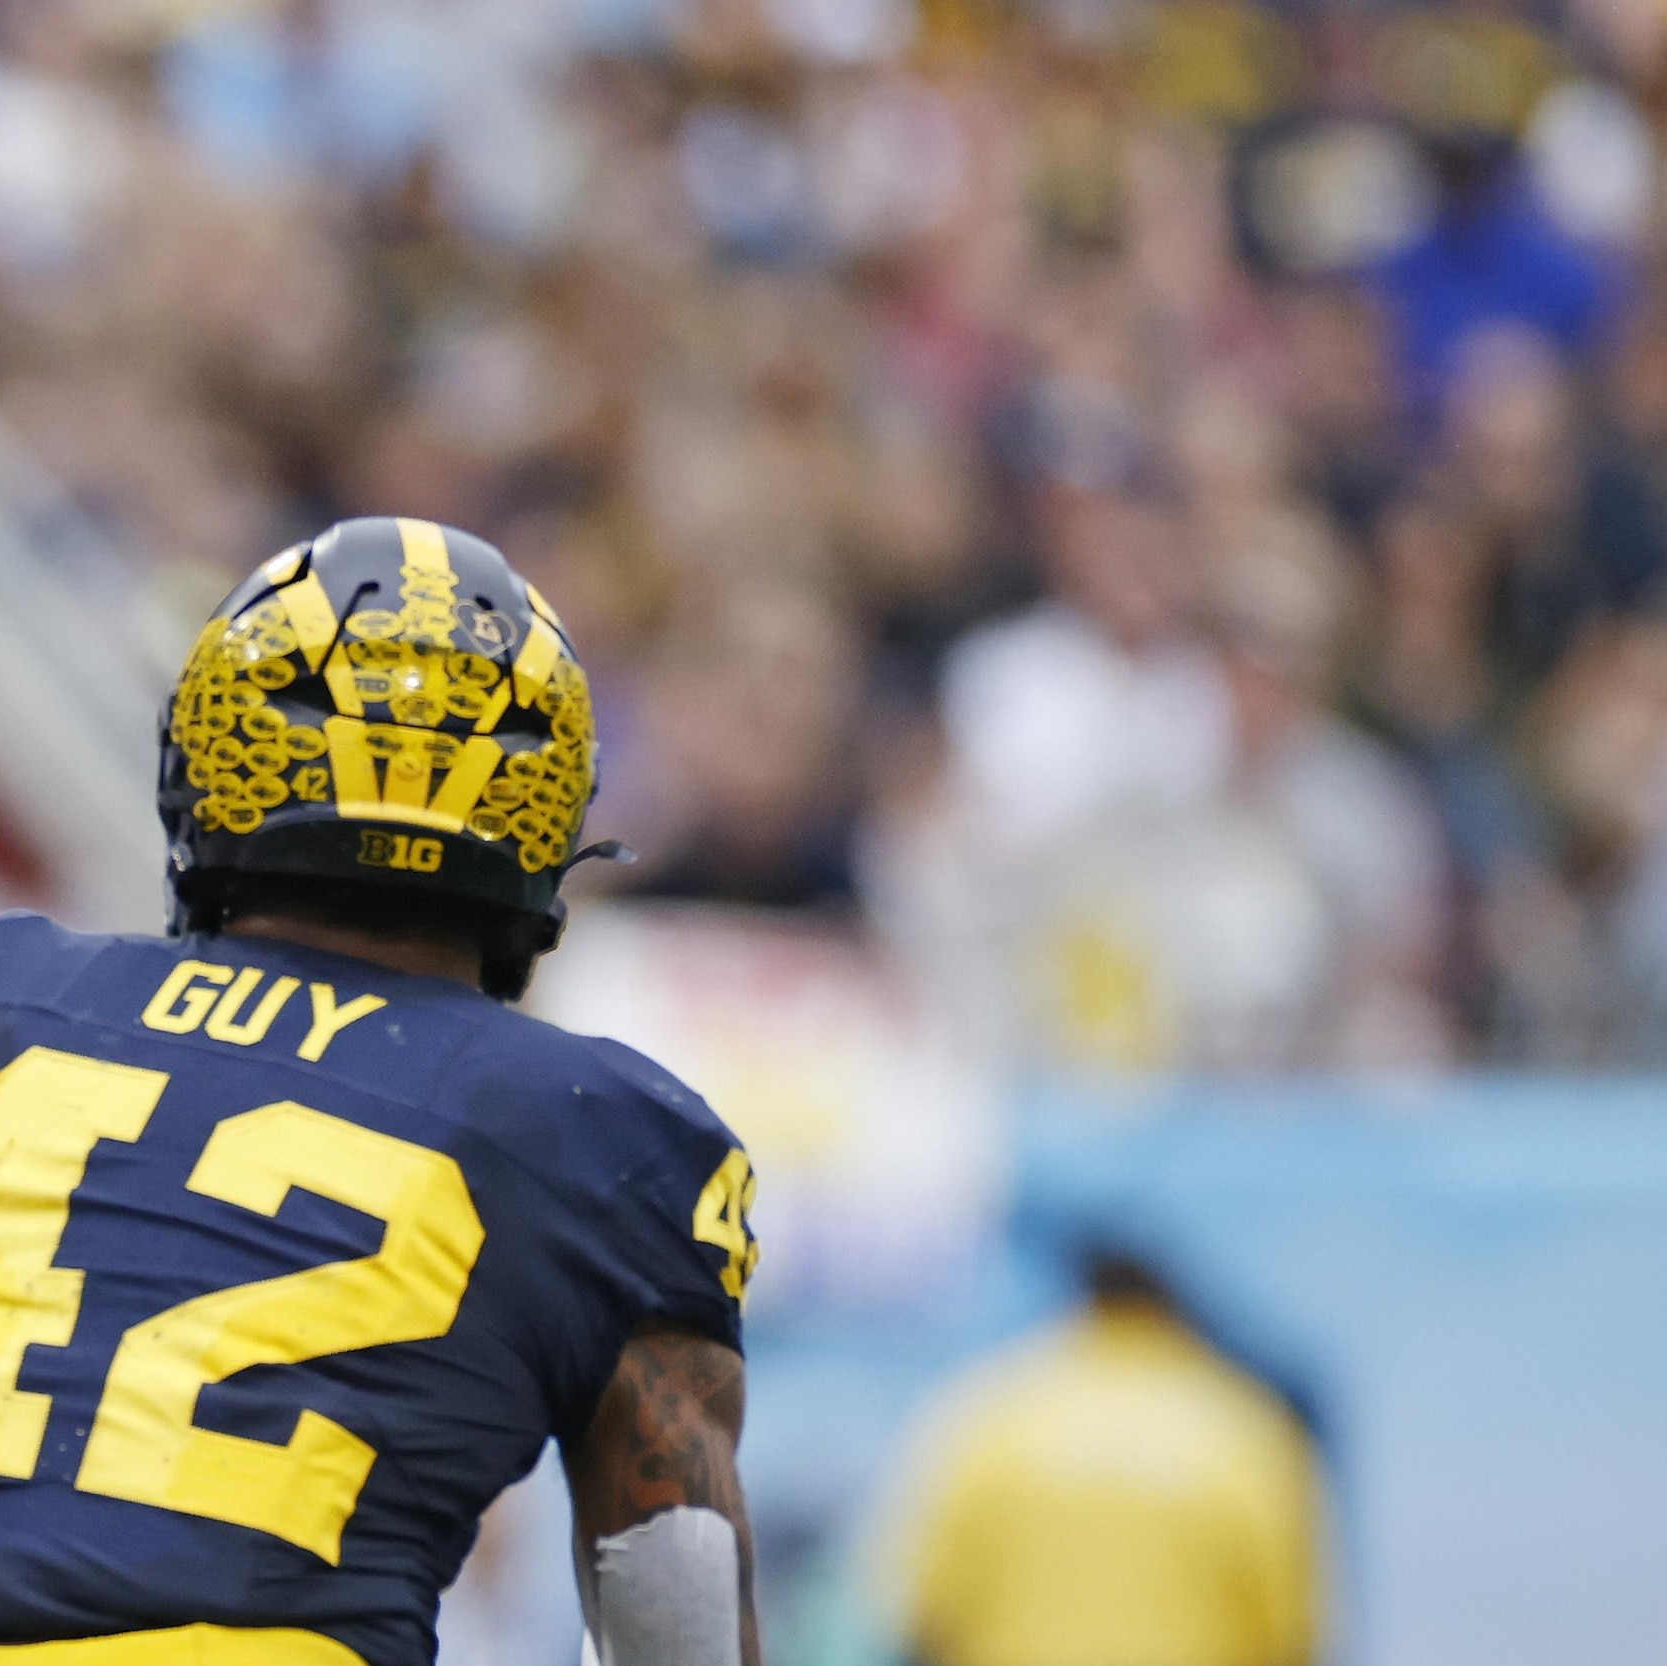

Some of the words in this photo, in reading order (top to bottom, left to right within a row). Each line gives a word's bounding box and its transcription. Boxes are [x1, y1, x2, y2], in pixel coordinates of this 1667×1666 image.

[291, 766, 330, 803] 42
[141, 959, 388, 1063] GUY
[692, 1146, 759, 1316] 4
